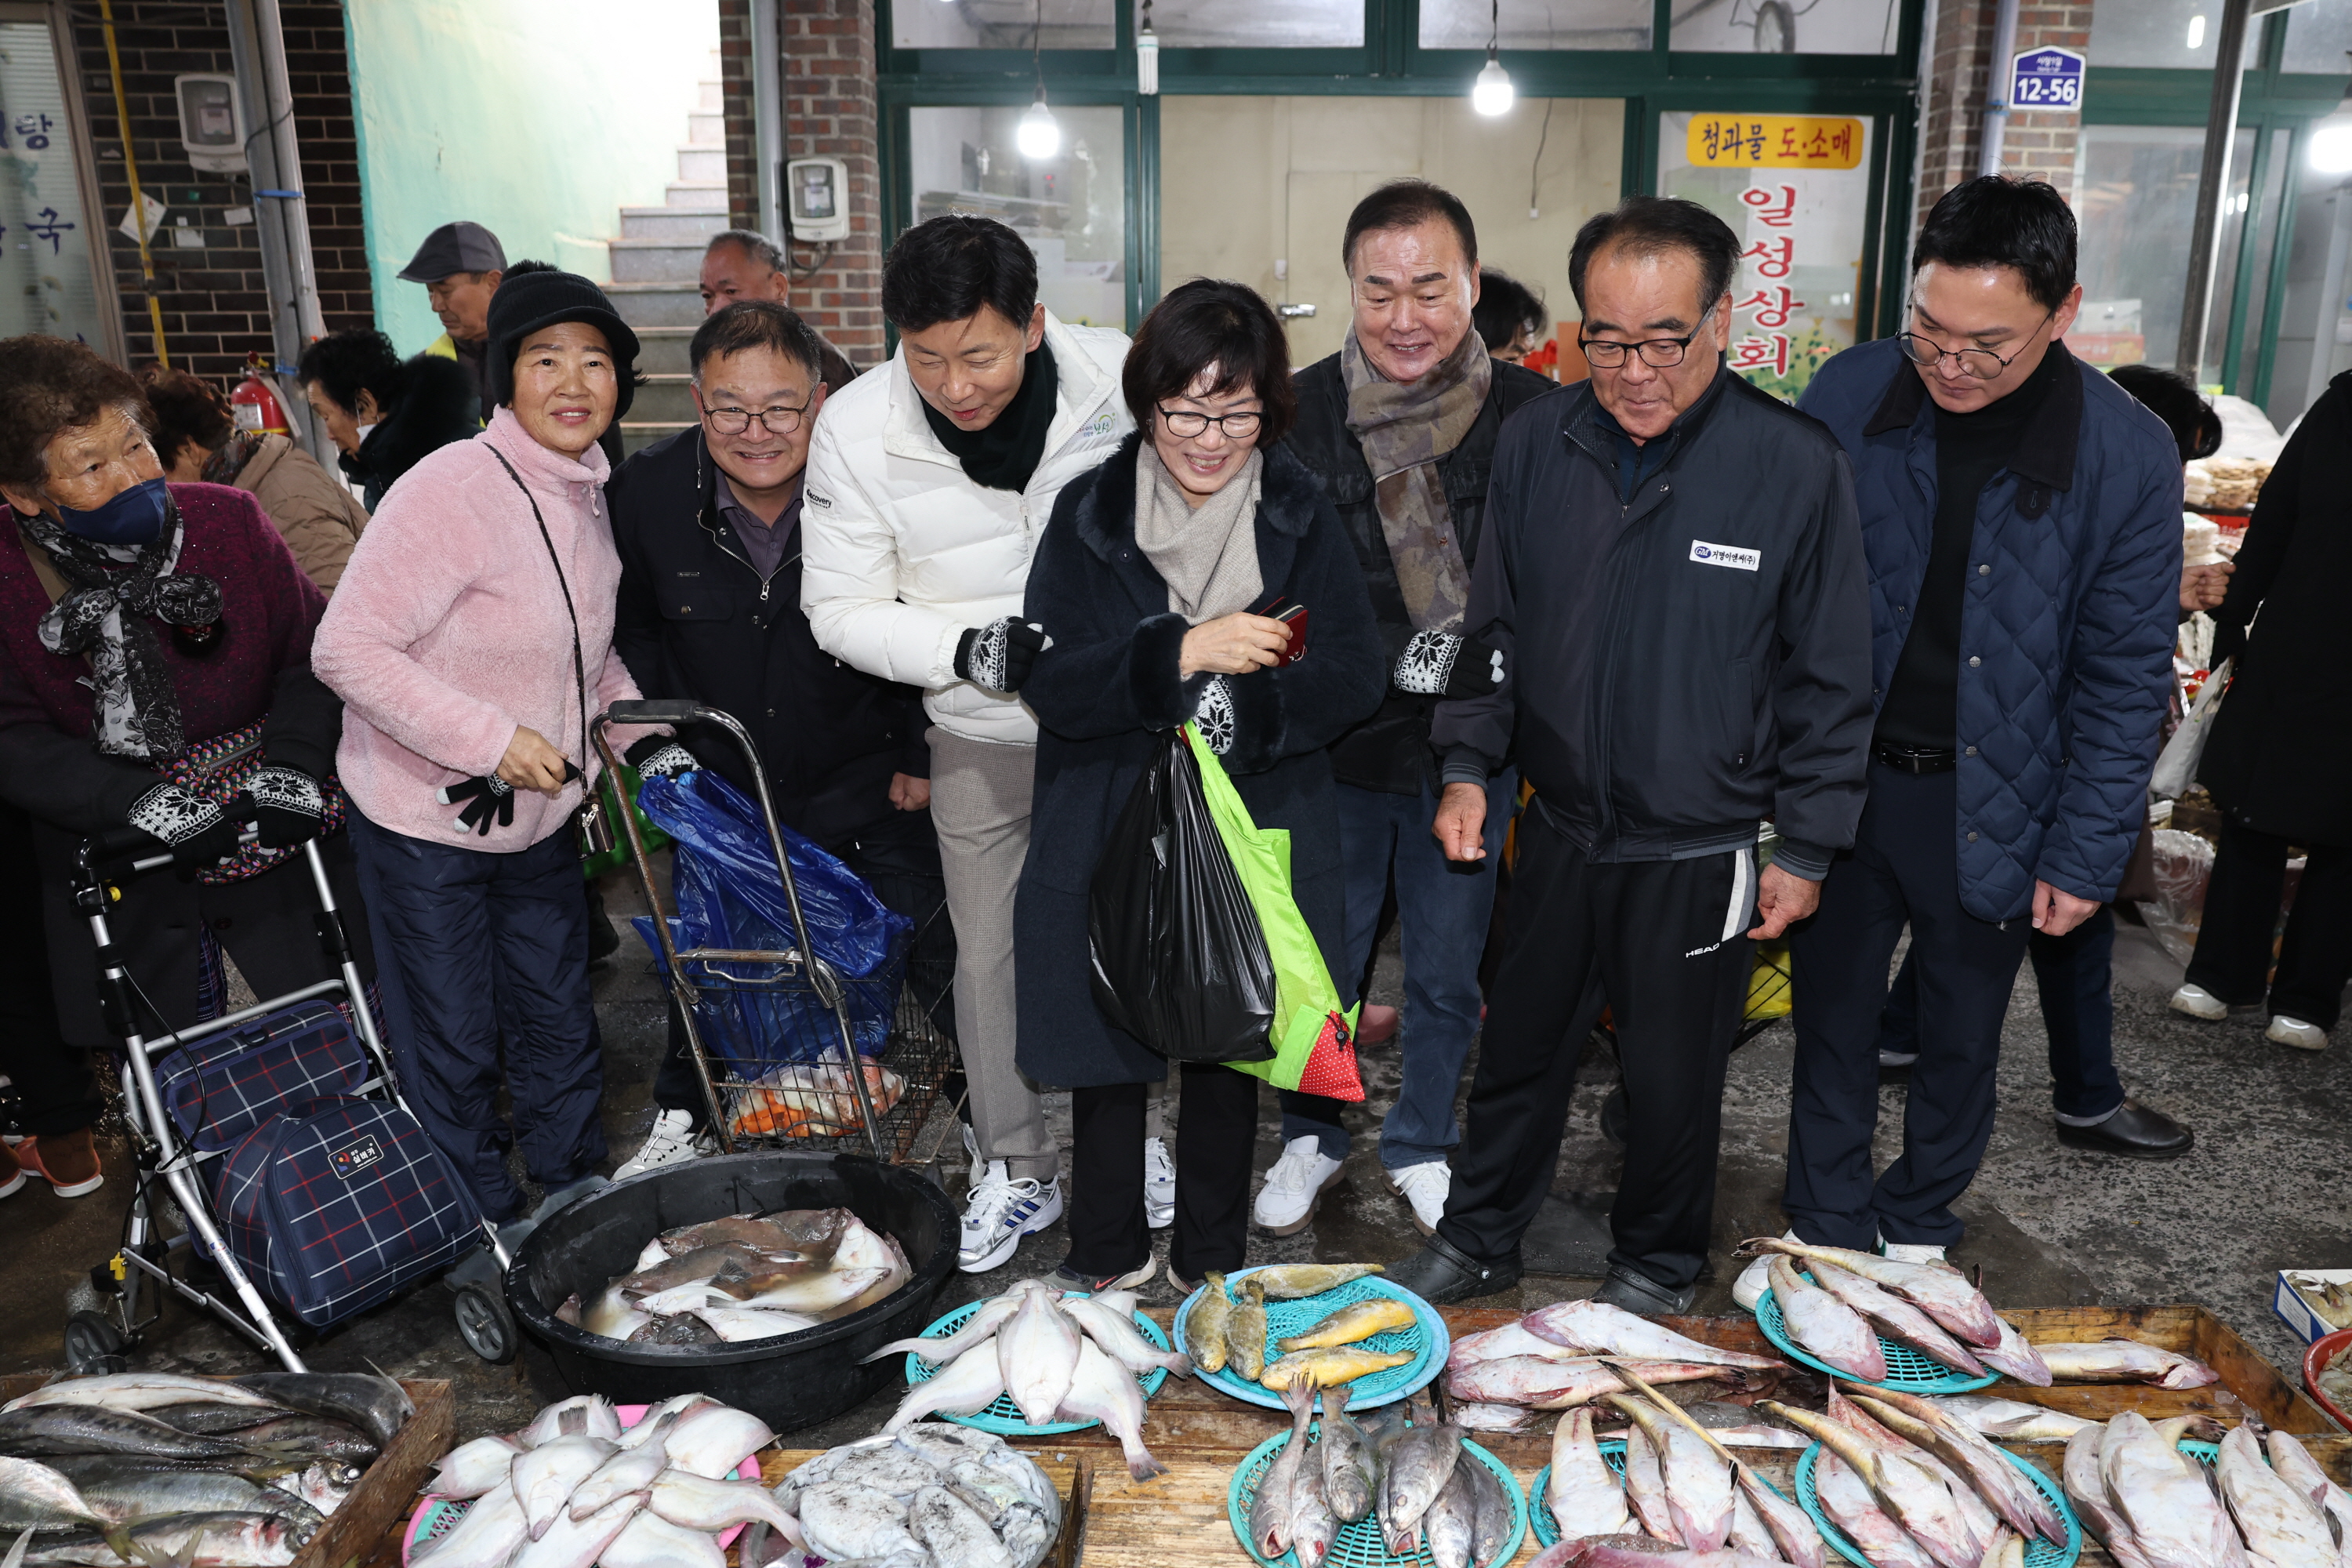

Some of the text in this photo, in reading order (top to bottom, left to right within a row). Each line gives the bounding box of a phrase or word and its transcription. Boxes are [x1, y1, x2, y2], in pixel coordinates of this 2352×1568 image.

[2017, 77, 2077, 102] 12-56
[1702, 121, 1851, 162] 청과물 도·소매
[1730, 185, 1806, 376] 일성상회
[1695, 547, 1709, 557] GM
[1686, 942, 1720, 958] HEAD
[353, 1147, 376, 1164] 실버카
